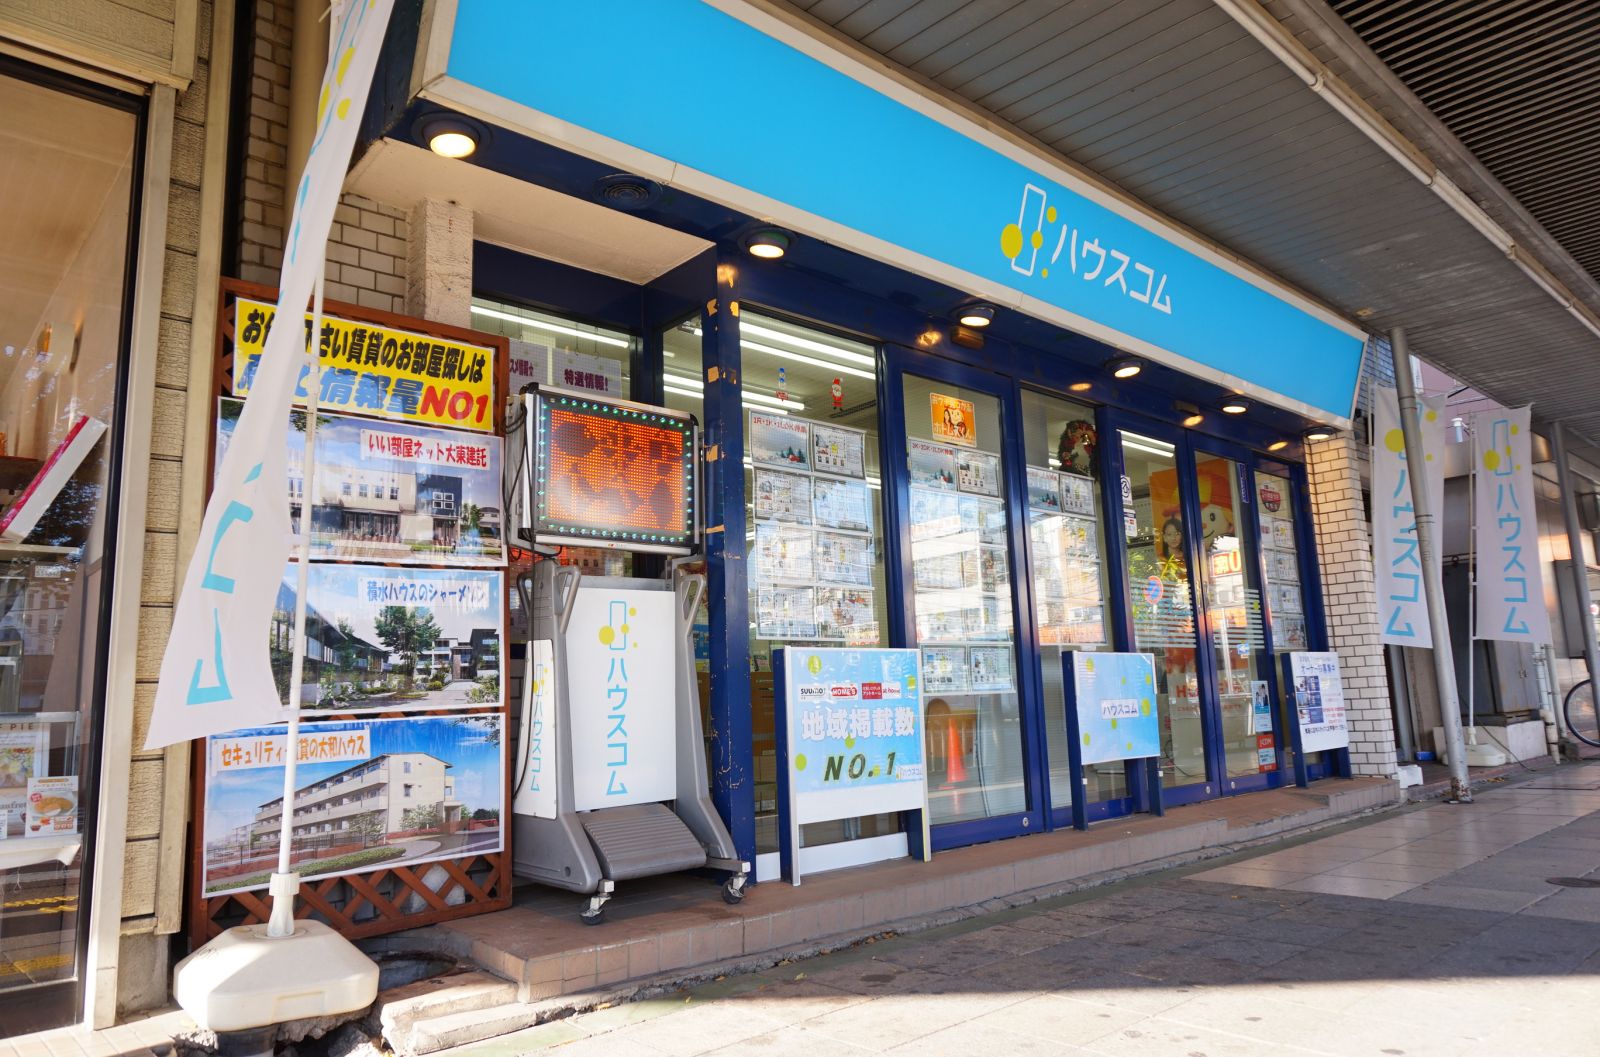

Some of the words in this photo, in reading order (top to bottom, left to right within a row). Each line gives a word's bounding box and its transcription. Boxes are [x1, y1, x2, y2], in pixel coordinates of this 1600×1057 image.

[1051, 223, 1171, 315] ハウスコム
[1497, 483, 1530, 634] ハウスコム
[606, 657, 629, 796] ハウスコム
[1103, 704, 1137, 716] ハウスコム
